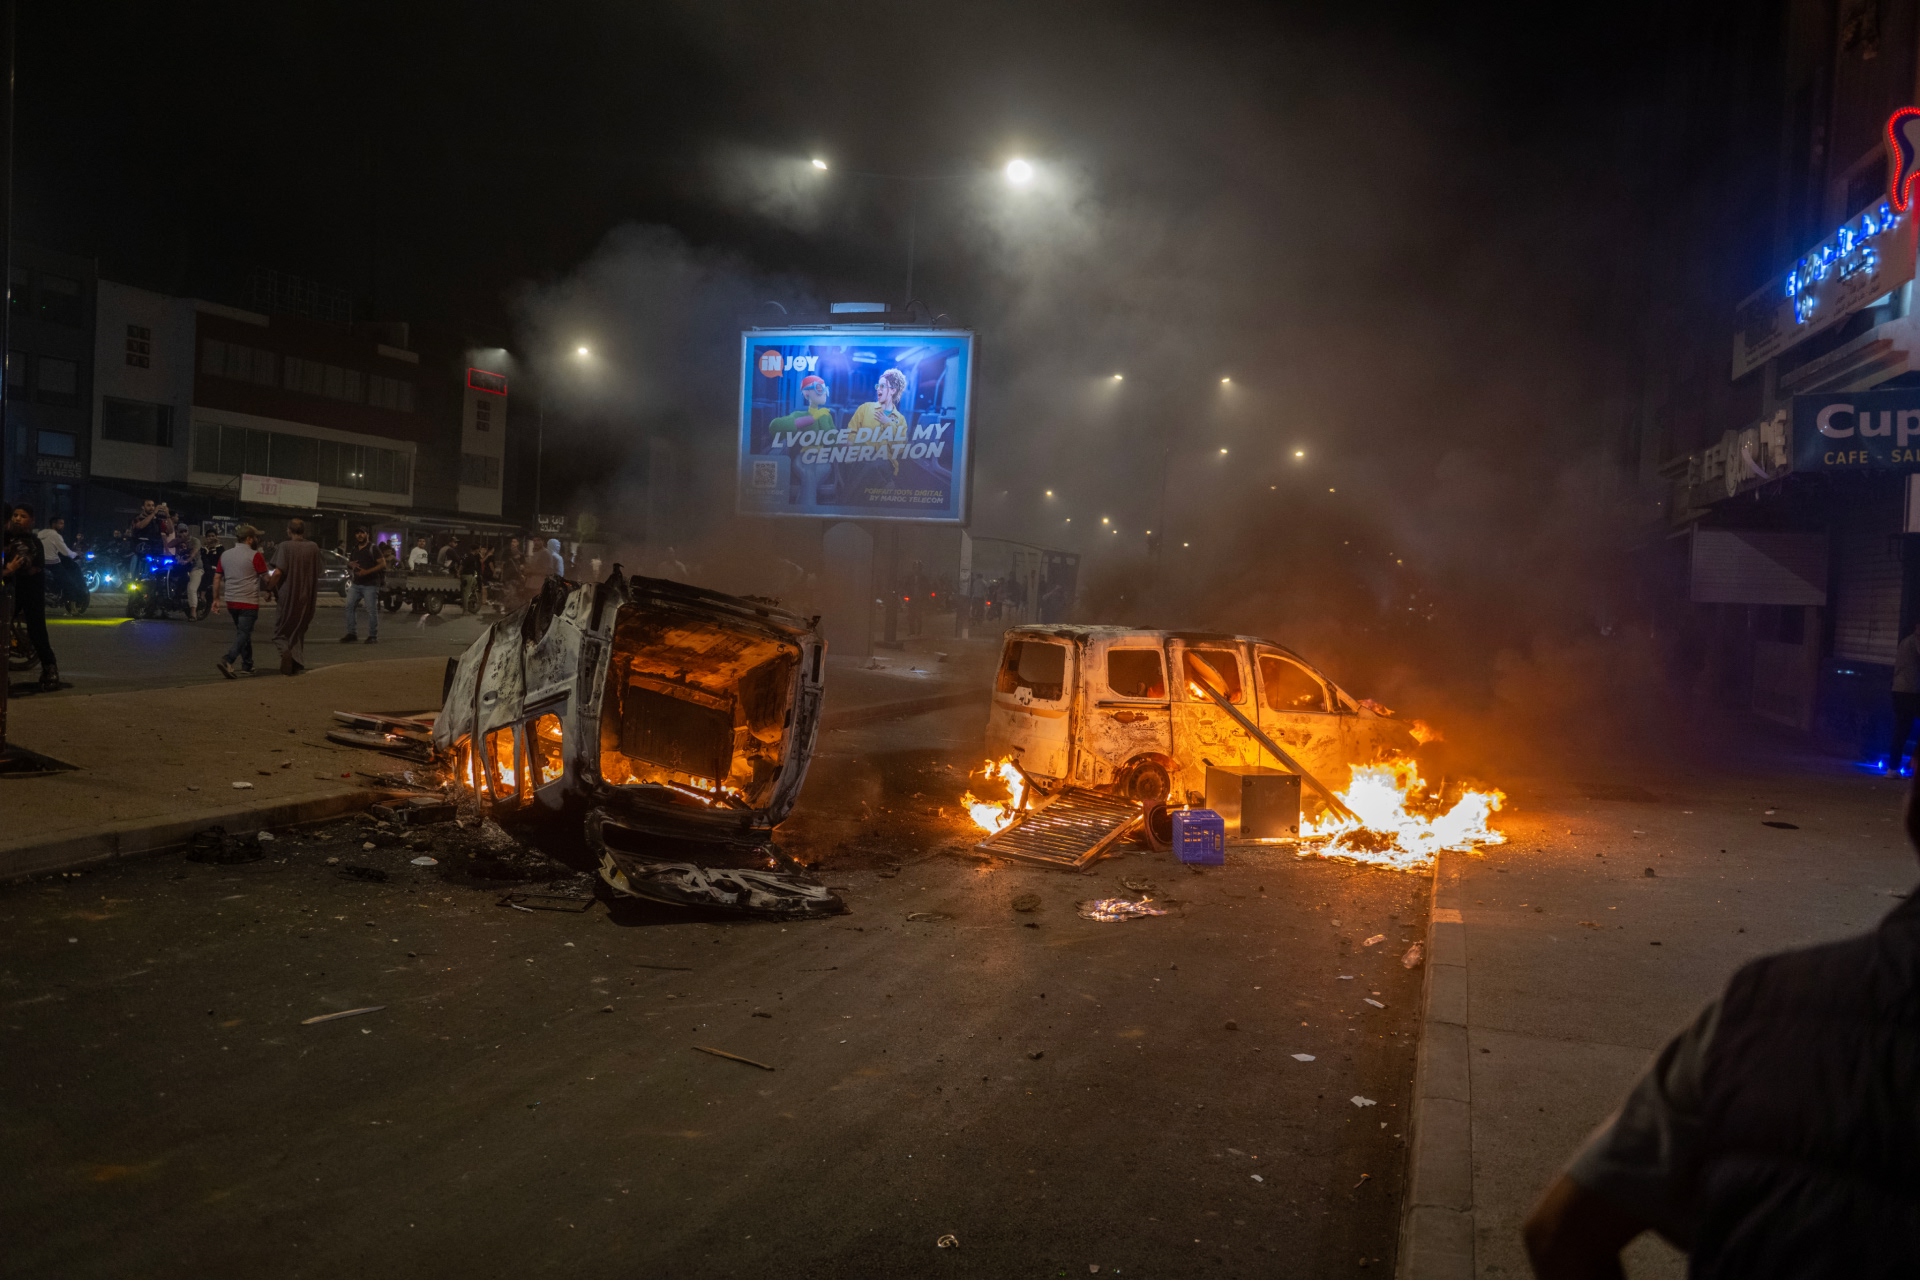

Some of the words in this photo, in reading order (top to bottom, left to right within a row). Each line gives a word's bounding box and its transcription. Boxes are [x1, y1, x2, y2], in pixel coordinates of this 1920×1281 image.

[1816, 403, 1920, 447] Cup
[771, 428, 853, 449] LVOICE
[854, 425, 907, 443] DIAL
[912, 422, 951, 441] MY
[801, 441, 946, 464] GENERATION
[1823, 450, 1869, 465] CAFE
[37, 467, 82, 478] FITNESS
[880, 495, 908, 503] MAROC
[909, 496, 944, 504] TELECOM
[894, 488, 913, 496] 100%
[914, 489, 944, 497] DIGITAL
